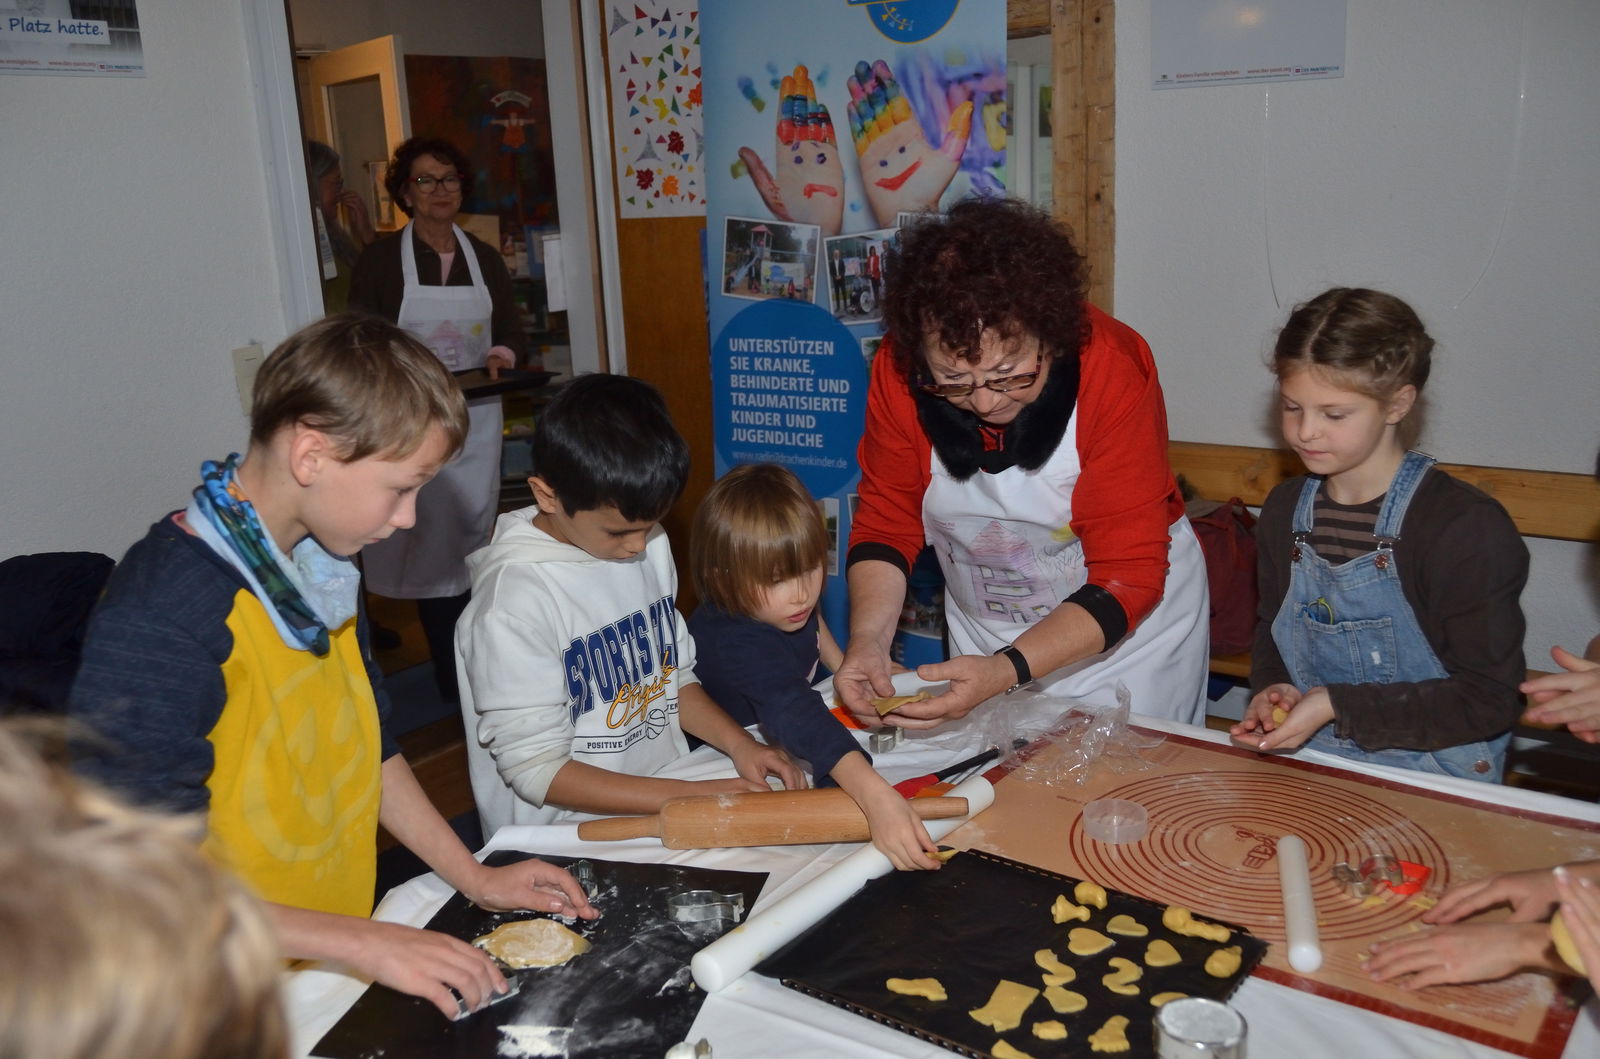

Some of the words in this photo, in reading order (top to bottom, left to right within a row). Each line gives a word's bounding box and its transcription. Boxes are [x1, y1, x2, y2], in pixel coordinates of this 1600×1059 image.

[9, 17, 52, 33] Platz
[58, 19, 104, 35] hatte.
[729, 337, 834, 355] UNTERSTÜTZEN
[730, 357, 750, 370] SIE
[754, 358, 815, 375] KRANKE,
[730, 374, 814, 392] BEHINDERTE
[819, 378, 850, 394] UND
[730, 392, 848, 413] TRAUMATISIERTE
[731, 410, 781, 426] KINDER
[786, 414, 816, 429] UND
[732, 428, 824, 448] JUGENDLICHE
[587, 741, 623, 750] POSITIVE
[624, 730, 643, 746] ENERGY
